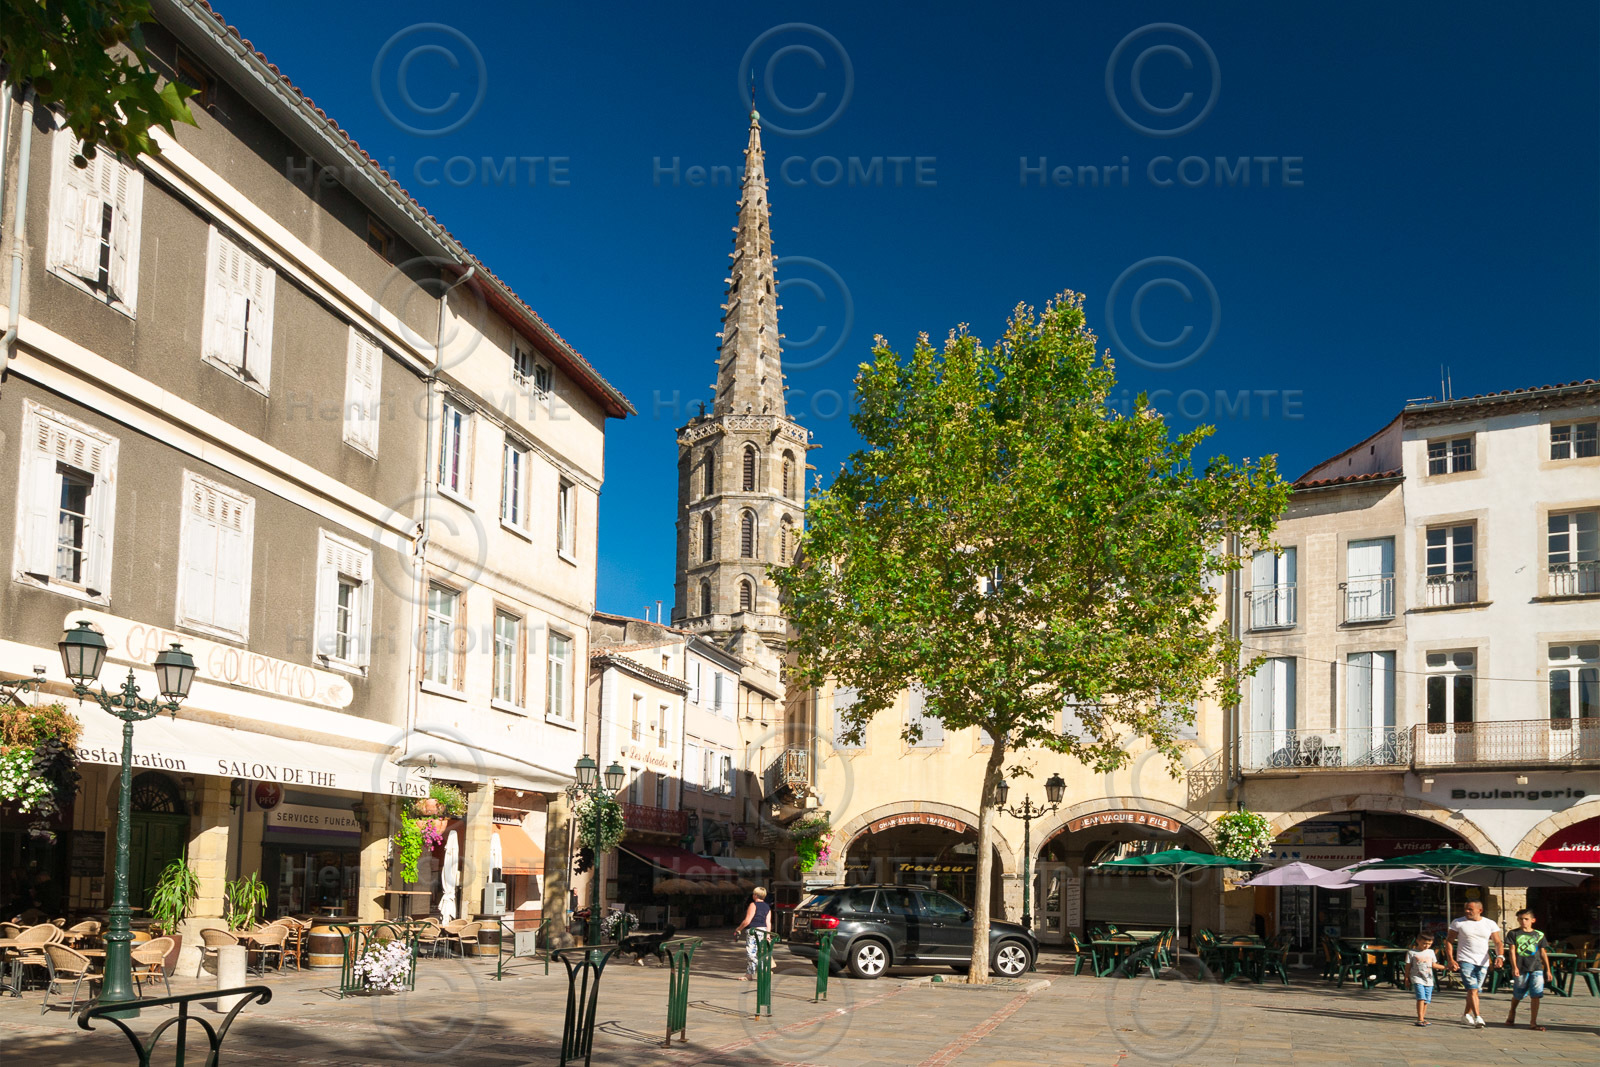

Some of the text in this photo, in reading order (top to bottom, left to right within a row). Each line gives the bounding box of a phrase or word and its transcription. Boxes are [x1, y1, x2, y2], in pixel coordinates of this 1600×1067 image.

[126, 625, 316, 700] CAF GOURMAND
[75, 747, 187, 770] estaration
[218, 759, 337, 787] SALON DE THE
[390, 780, 427, 797] TAPAS
[1451, 788, 1586, 800] Boulangerie
[259, 796, 275, 804] PFG
[277, 812, 361, 829] SERVICES FUNÉRAI
[926, 817, 956, 828] TRAITEUR
[1081, 817, 1100, 827] JEAN
[1102, 814, 1134, 822] VAQUIE
[1149, 817, 1168, 827] FILS
[1393, 842, 1432, 850] Artisan
[899, 863, 974, 872] Traiteur
